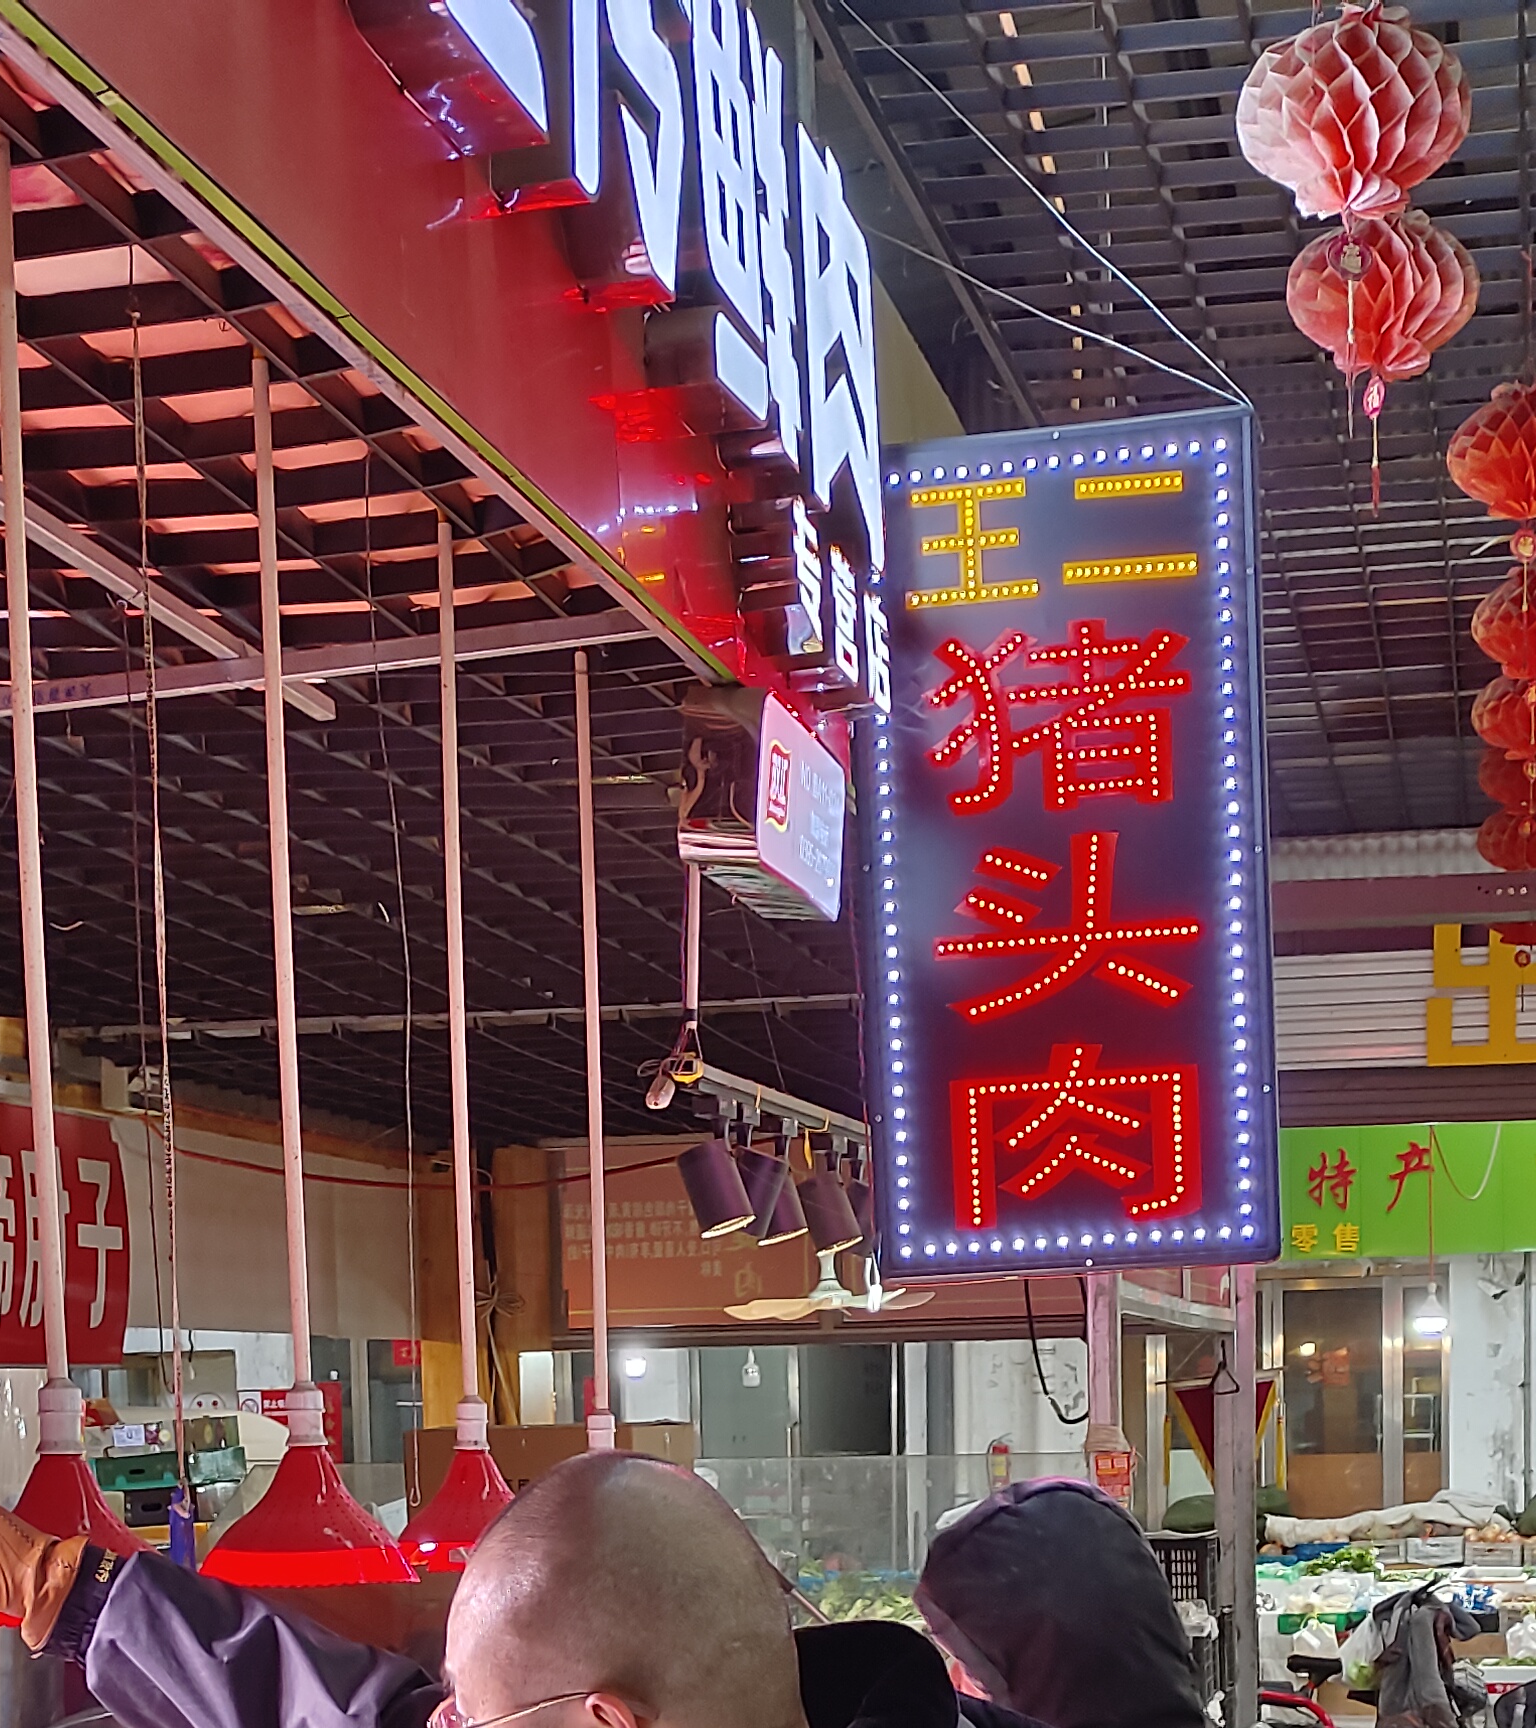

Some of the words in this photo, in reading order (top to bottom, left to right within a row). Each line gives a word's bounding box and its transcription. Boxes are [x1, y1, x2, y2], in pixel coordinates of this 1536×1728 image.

[922, 617, 1202, 1232] 猪头肉
[1290, 1221, 1361, 1254] 零售
